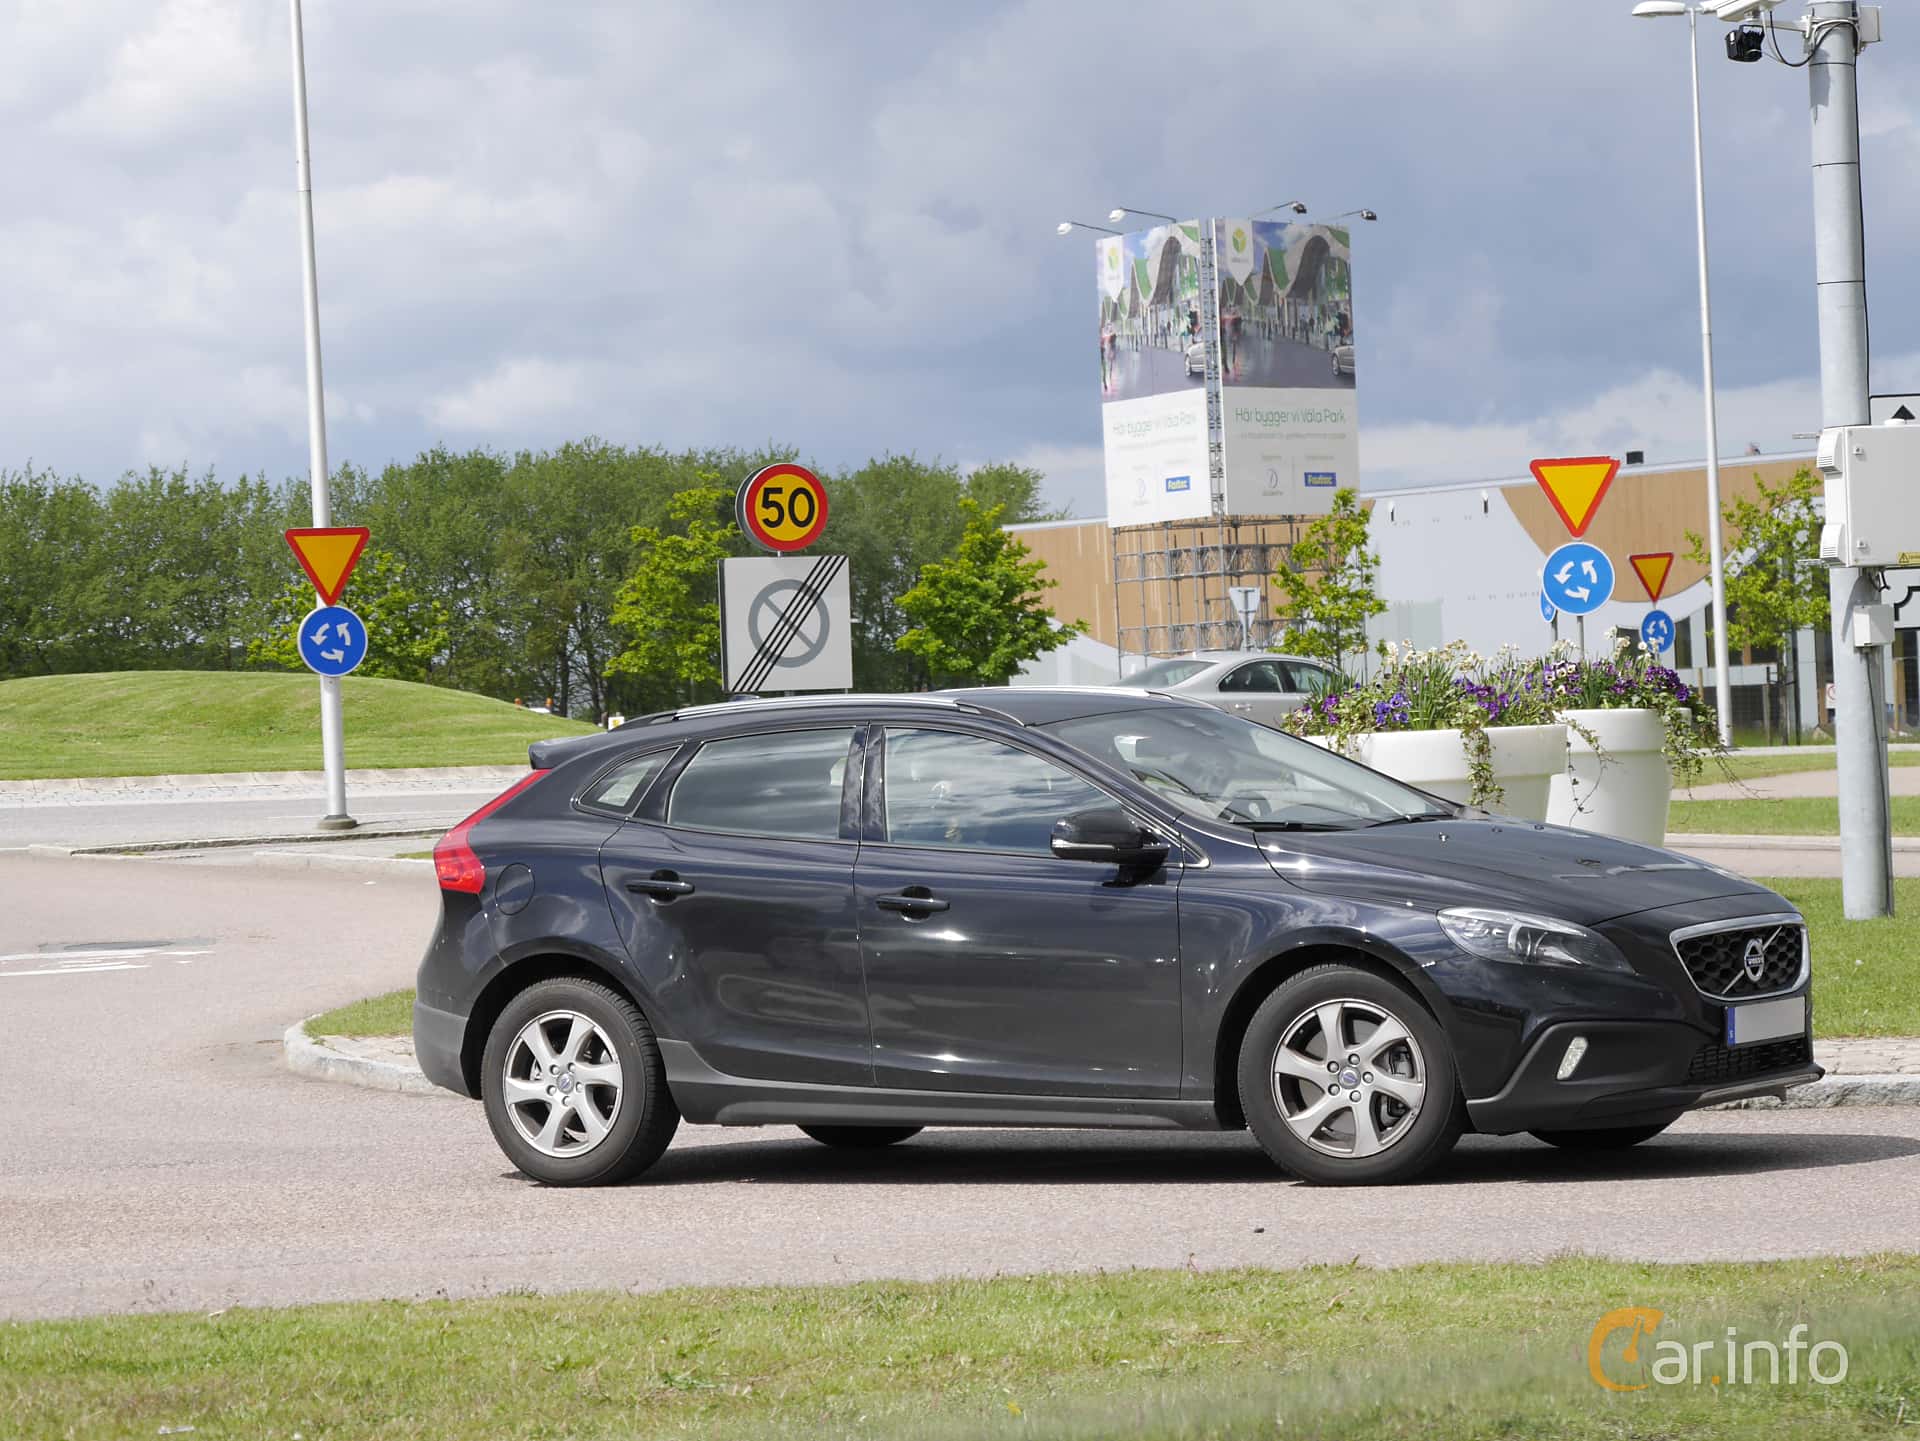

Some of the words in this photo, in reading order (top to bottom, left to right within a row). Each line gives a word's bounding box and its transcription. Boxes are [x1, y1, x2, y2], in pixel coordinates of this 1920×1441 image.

[1256, 408, 1290, 427] bygger
[1324, 408, 1346, 423] Park
[762, 487, 815, 528] 50
